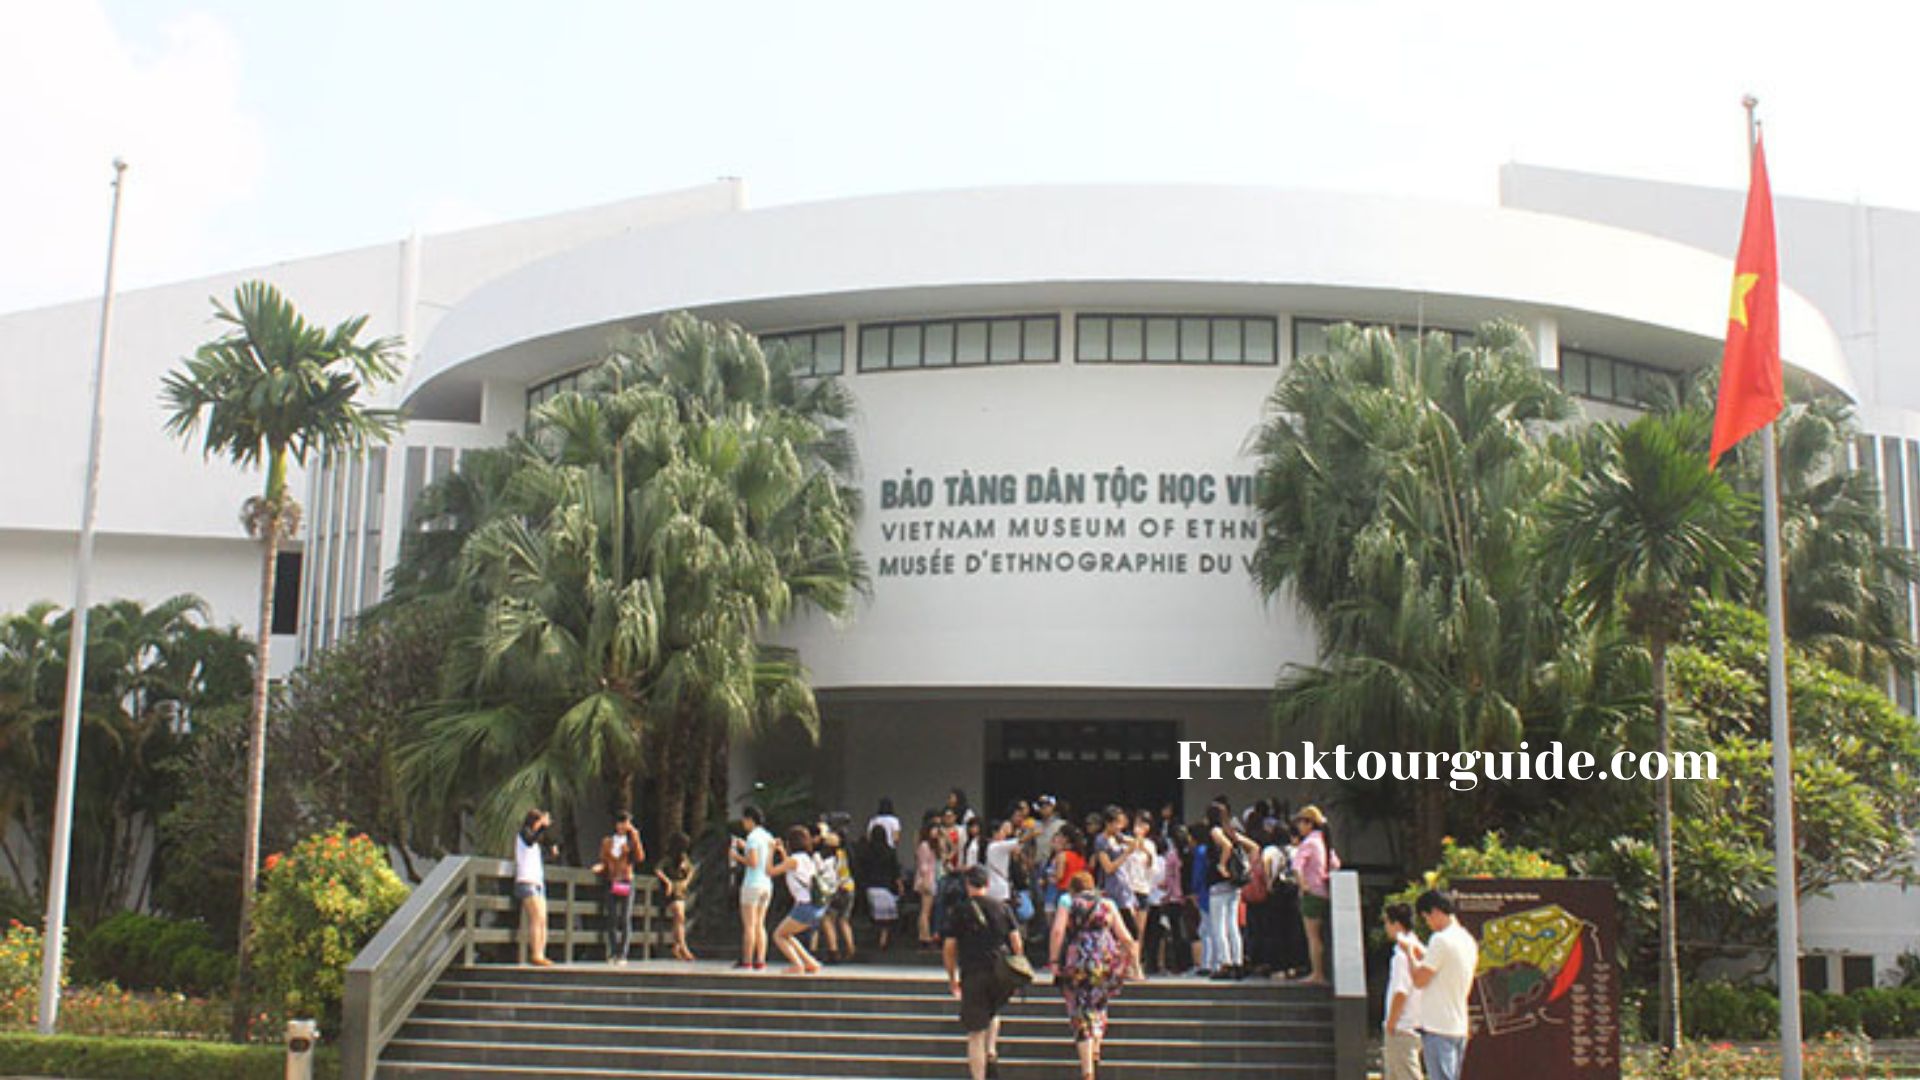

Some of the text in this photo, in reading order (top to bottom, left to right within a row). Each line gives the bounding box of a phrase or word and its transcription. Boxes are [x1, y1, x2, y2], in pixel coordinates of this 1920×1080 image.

[881, 468, 934, 509] BẢO
[943, 469, 1017, 507] TÀNG
[1026, 467, 1085, 505] DÂN
[1093, 466, 1148, 509] TỘC
[1158, 473, 1216, 510] HỌC
[881, 518, 995, 541] VIETNAM
[1008, 517, 1126, 538] MUSEUM
[1138, 517, 1175, 538] OF
[879, 548, 955, 576] MUSÉE
[966, 549, 1187, 574] D'ETHNOGRAPHIE
[1201, 553, 1232, 574] DU
